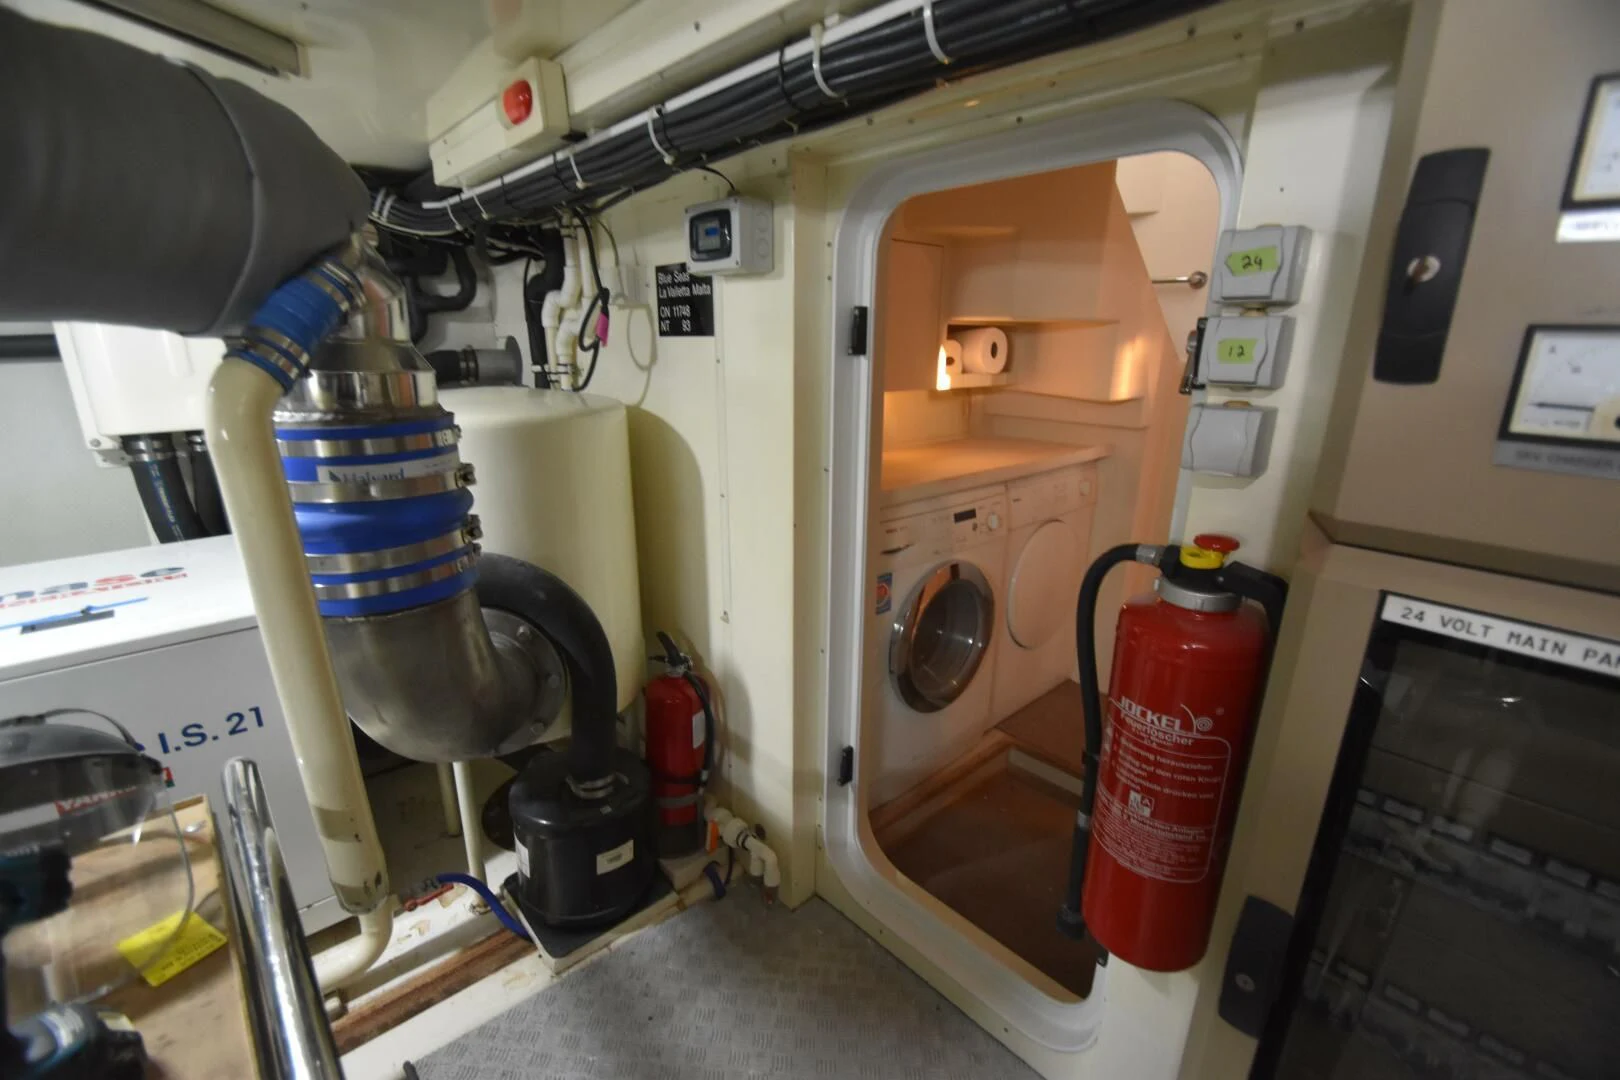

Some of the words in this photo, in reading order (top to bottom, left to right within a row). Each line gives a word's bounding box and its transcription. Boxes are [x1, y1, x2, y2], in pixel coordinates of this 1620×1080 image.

[1241, 255, 1263, 271] 24
[658, 272, 673, 284] Blue
[659, 287, 668, 298] La
[691, 283, 711, 296] Malta
[660, 320, 670, 332] NT
[1228, 345, 1245, 358] 12
[1400, 606, 1427, 623] 24
[1438, 614, 1495, 640] VOLT
[1506, 631, 1569, 656] MAIN
[1119, 696, 1183, 732] JOCKEL
[158, 723, 219, 754] I.S.
[226, 706, 265, 736] 21
